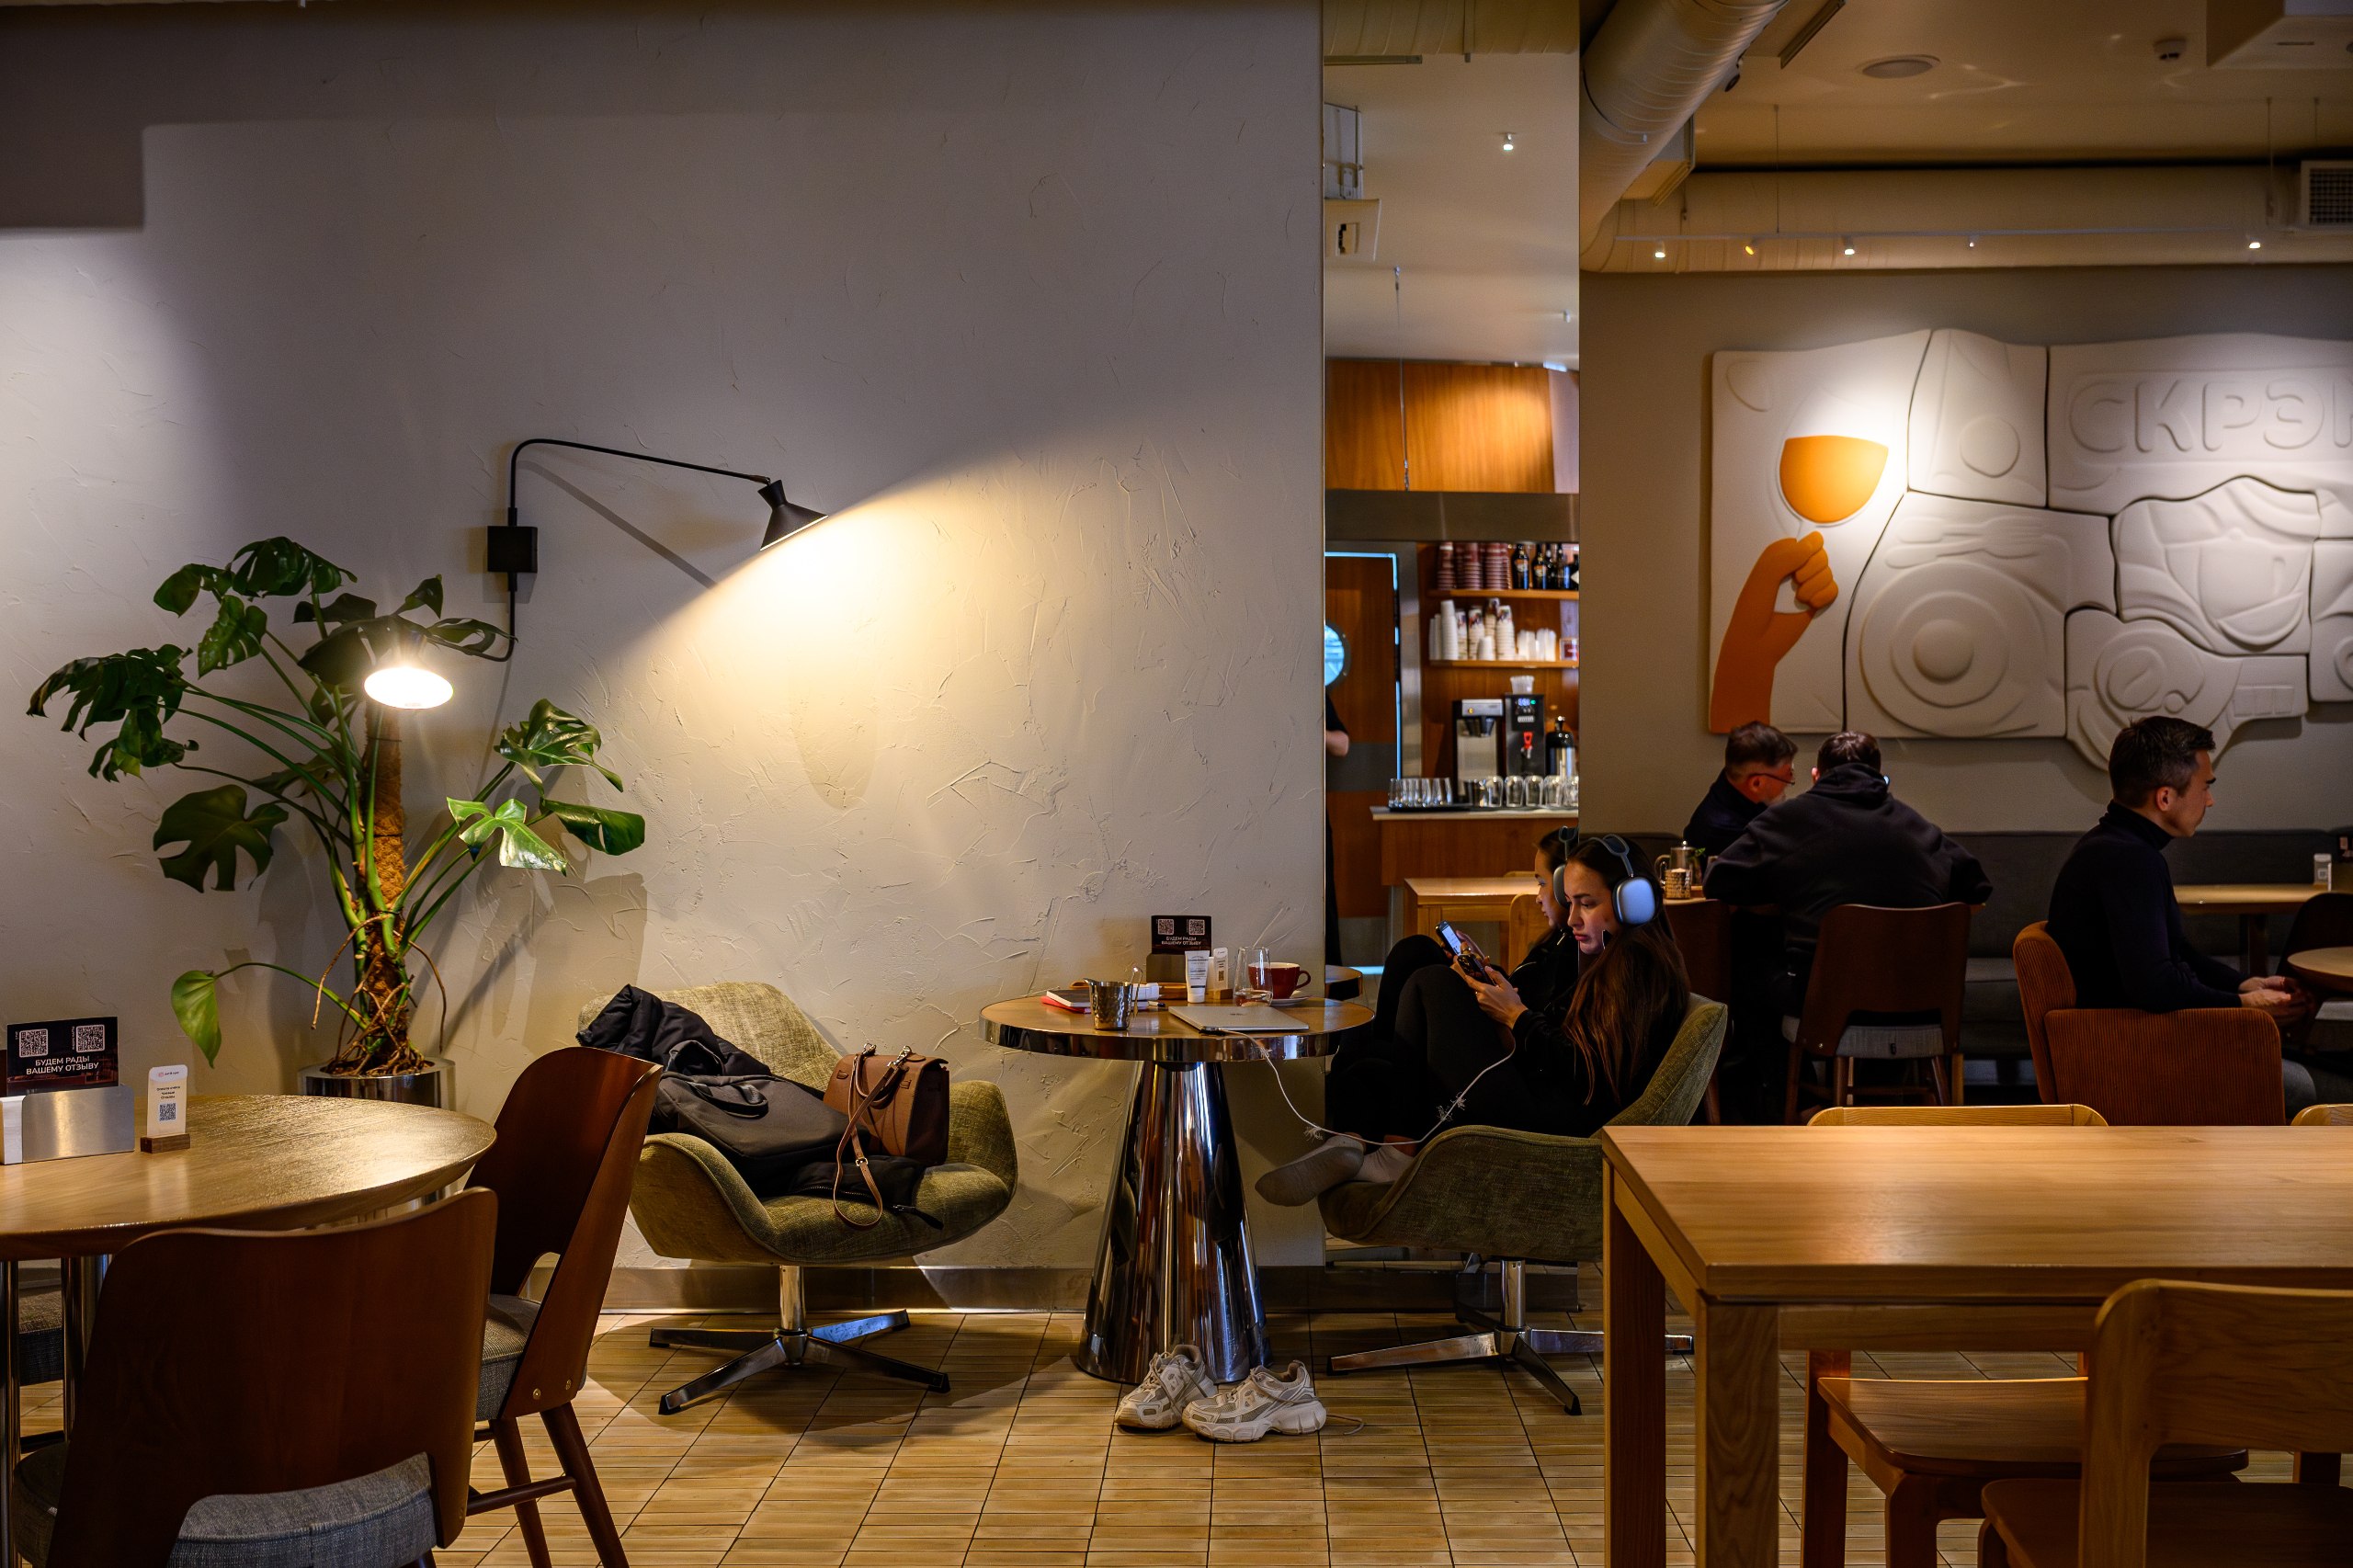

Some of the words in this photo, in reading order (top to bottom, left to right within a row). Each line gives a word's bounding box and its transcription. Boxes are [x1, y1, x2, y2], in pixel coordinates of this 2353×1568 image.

[35, 1057, 63, 1066] БУДЕМ
[65, 1055, 90, 1064] РАДЫ
[26, 1065, 63, 1075] ВАШЕМУ
[64, 1062, 99, 1072] ОТЗЫВУ
